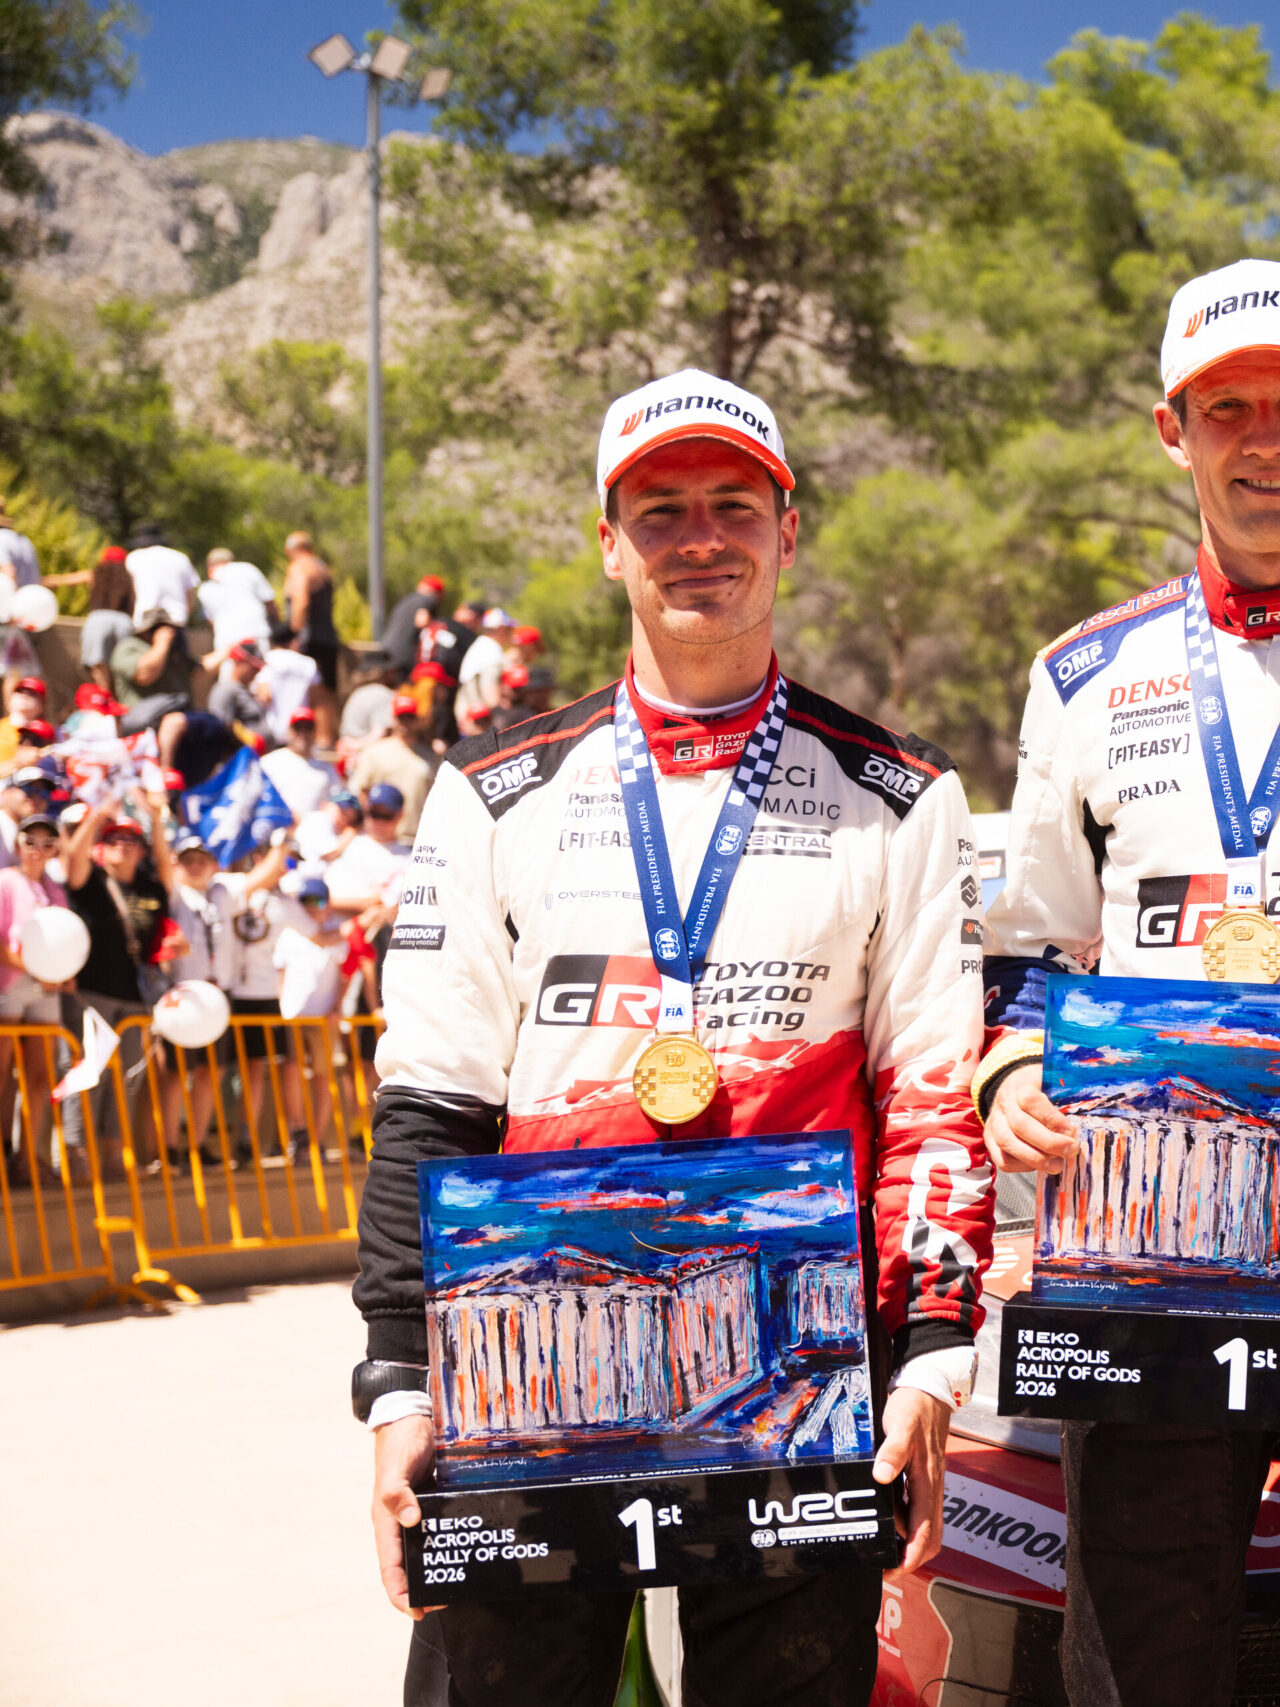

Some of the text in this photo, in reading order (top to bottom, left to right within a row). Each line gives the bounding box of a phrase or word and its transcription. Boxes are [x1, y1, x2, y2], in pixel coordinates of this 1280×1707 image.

[1058, 643, 1104, 681] OMP
[1111, 699, 1190, 722] Panasonic
[1109, 712, 1192, 736] AUTOMOTIVE
[676, 745, 711, 759] GR
[481, 758, 538, 797] OMP
[863, 759, 921, 796] OMP
[1265, 779, 1279, 796] FIA
[1117, 779, 1182, 804] PRADA
[1212, 735, 1244, 850] FIA PRESIDENT'S MEDAL
[759, 798, 841, 820] MADIC
[637, 800, 667, 914] FIA PRESIDENT'S MEDAL
[688, 868, 722, 949] FIA PRESIDENT'S
[699, 960, 832, 983] TOYOTA
[540, 983, 661, 1026] GR
[693, 985, 813, 1006] GAZOO
[1036, 1331, 1080, 1346] EKO
[1017, 1346, 1110, 1364] ACROPOLIS
[1016, 1362, 1141, 1383] RALLY OF GODS
[1213, 1337, 1278, 1410] 1st
[1015, 1380, 1057, 1397] 2026
[748, 1489, 877, 1526] WRC
[440, 1516, 483, 1531] EKO
[617, 1498, 683, 1571] 1st
[423, 1528, 516, 1549] ACROPOLIS
[782, 1534, 876, 1546] CHAMPIONSHIP
[423, 1543, 549, 1567] RALLY OF GODS
[424, 1567, 466, 1584] 2026
